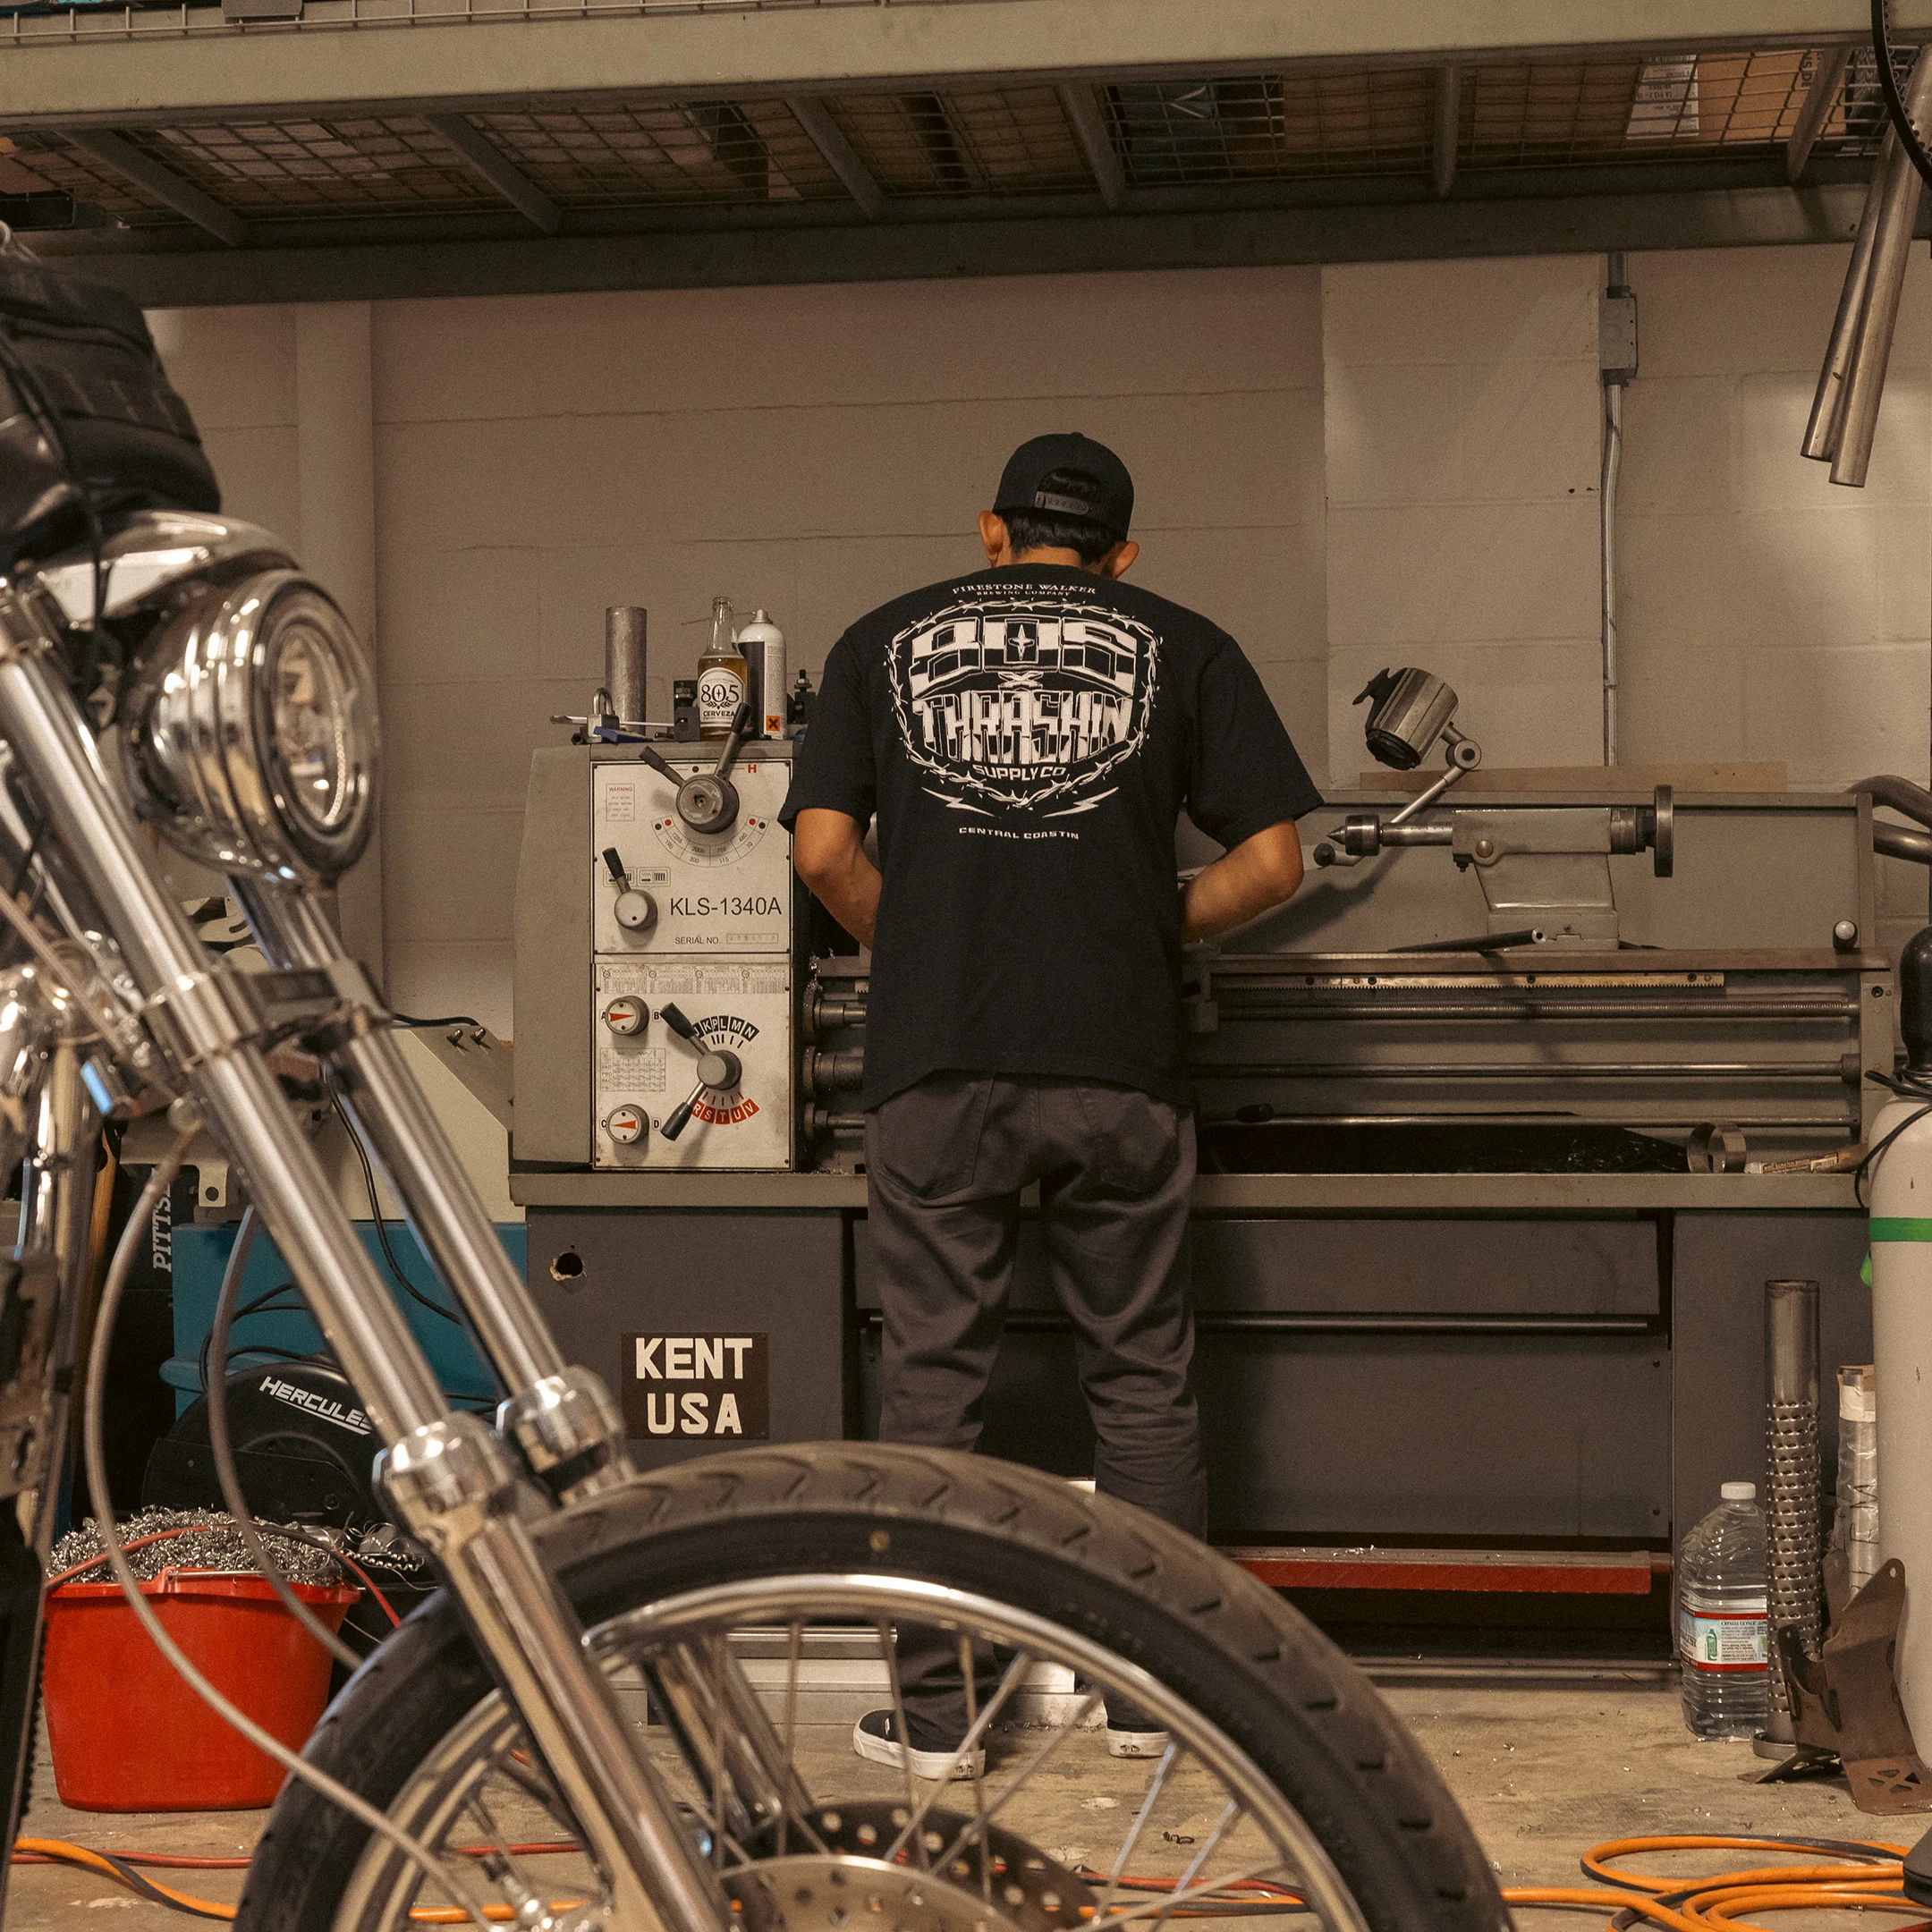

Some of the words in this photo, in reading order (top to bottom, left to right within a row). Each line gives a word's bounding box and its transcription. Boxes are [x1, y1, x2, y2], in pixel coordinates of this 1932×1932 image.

[952, 583, 1033, 595] FIRESTONE
[1038, 584, 1097, 595] WALKER
[909, 615, 1138, 699] 805
[700, 683, 740, 703] 805
[911, 690, 1133, 764] THRASHIN
[747, 764, 758, 774] H
[958, 826, 1021, 839] CENTRAL
[670, 897, 783, 916] KLS-1340A
[674, 936, 704, 945] SERIAL
[600, 1012, 606, 1020] A
[654, 1012, 660, 1020] B
[703, 1021, 712, 1030] K
[720, 1018, 726, 1029] L
[732, 1021, 741, 1030] M
[746, 1028, 755, 1038] N
[704, 1110, 712, 1119] S
[719, 1112, 726, 1122] T
[734, 1110, 741, 1120] U
[746, 1103, 754, 1113] V
[600, 1120, 606, 1128] C
[654, 1120, 659, 1128] D
[152, 1182, 172, 1272] PITTS
[636, 1337, 753, 1379] KENT
[647, 1393, 742, 1435] USA
